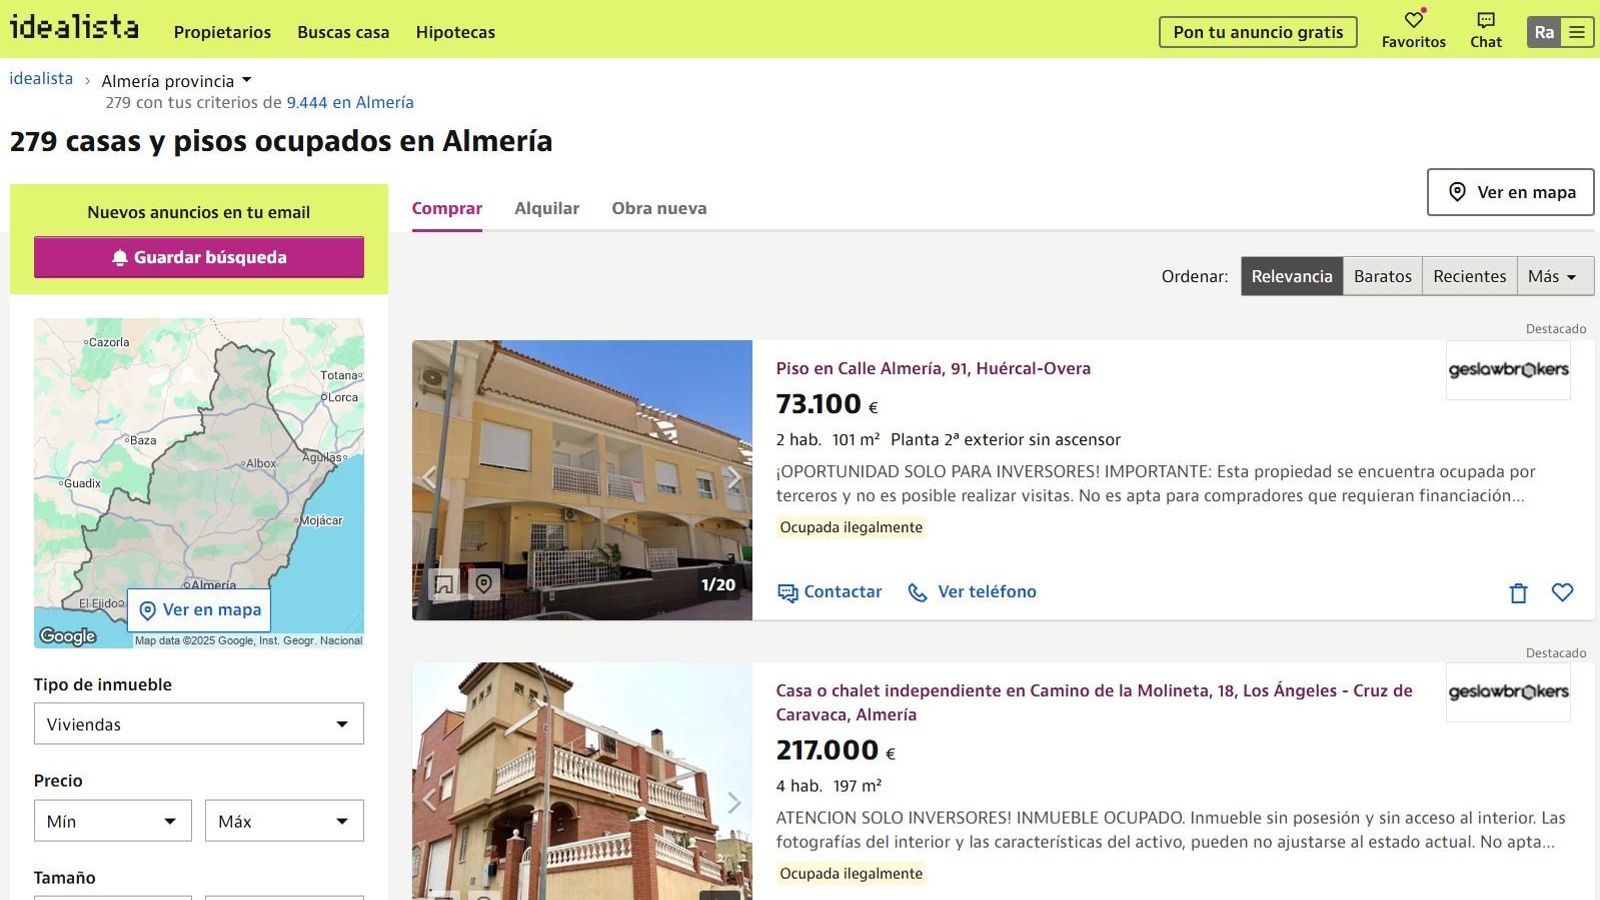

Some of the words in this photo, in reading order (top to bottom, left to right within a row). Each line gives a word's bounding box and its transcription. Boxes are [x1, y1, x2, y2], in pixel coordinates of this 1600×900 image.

[9, 13, 139, 41] idealista
[174, 24, 272, 42] Propietarios
[297, 24, 351, 39] Buscas
[355, 28, 390, 39] casa
[416, 25, 496, 42] Hipotecas
[1173, 25, 1205, 39] Pon
[1207, 26, 1226, 39] tu
[1230, 25, 1294, 39] anuncio
[1297, 25, 1344, 42] gratis
[1535, 25, 1555, 39] Ra
[1382, 35, 1447, 48] Favoritos
[1470, 35, 1503, 49] Chat
[9, 71, 73, 85] idealista
[101, 74, 160, 88] Almería
[165, 74, 235, 91] provincia
[196, 95, 258, 109] criterios
[286, 96, 328, 109] 9.444
[355, 95, 414, 109] Almería
[66, 134, 141, 153] casas
[174, 128, 247, 158] pisos
[255, 128, 392, 158] ocupados
[441, 128, 553, 153] Almería
[1477, 185, 1504, 199] Ver
[1508, 188, 1528, 199] en
[1532, 188, 1577, 202] mapa
[87, 205, 146, 219] Nuevos
[149, 205, 219, 219] anuncios
[246, 206, 264, 219] tu
[267, 205, 310, 219] email
[411, 201, 484, 218] Comprar
[514, 201, 581, 218] Alquilar
[611, 201, 653, 215] Obra
[657, 204, 707, 215] nueva
[133, 249, 202, 265] Guardar
[205, 249, 288, 267] búsqueda
[1161, 269, 1229, 283] Ordenar:
[1252, 268, 1333, 284] Relevancia
[1354, 269, 1413, 283] Baratos
[1434, 269, 1507, 283] Recientes
[1528, 269, 1560, 283] Más
[1526, 323, 1587, 334] Destacado
[89, 336, 130, 348] Cazorla
[320, 370, 356, 381] Totana
[776, 361, 810, 376] Piso
[837, 361, 877, 375] Calle
[879, 361, 946, 378] Almería,
[976, 361, 1092, 376] Huércal-Overa
[328, 391, 358, 402] Lorca
[775, 392, 862, 415] 73.100
[130, 435, 156, 446] Baza
[789, 432, 822, 447] hab.
[890, 432, 940, 447] Planta
[963, 432, 1025, 447] exterior
[1055, 435, 1122, 447] ascensor
[246, 458, 276, 468] Albox
[776, 464, 900, 481] ¡OPORTUNIDAD
[904, 464, 947, 479] SOLO
[951, 464, 993, 478] PARA
[996, 464, 1100, 479] INVERSORES!
[1105, 464, 1212, 479] IMPORTANTE:
[1217, 464, 1249, 479] Esta
[1254, 464, 1332, 481] propiedad
[1358, 465, 1435, 479] encuentra
[1439, 464, 1505, 481] ocupada
[64, 478, 101, 489] Guadix
[776, 489, 838, 503] terceros
[901, 488, 957, 505] posible
[961, 488, 1017, 503] realizar
[1021, 488, 1074, 503] visitas.
[1126, 489, 1161, 505] apta
[1166, 491, 1199, 505] para
[1204, 488, 1304, 505] compradores
[1308, 491, 1337, 505] que
[1342, 488, 1415, 506] requieran
[1418, 488, 1525, 503] financiación...
[300, 514, 342, 526] Mojácar
[779, 520, 840, 536] Ocupada
[843, 520, 923, 537] ilegalmente
[192, 580, 236, 589] Almería
[701, 576, 736, 592] 1/20
[804, 584, 883, 599] Contactar
[937, 584, 965, 599] Ver
[968, 584, 1037, 599] teléfono
[79, 598, 89, 608] El
[92, 598, 117, 609] Ejido
[162, 602, 190, 617] Ver
[193, 605, 214, 617] en
[218, 605, 262, 620] mapa
[39, 626, 97, 648] Google
[135, 635, 157, 647] Map
[158, 635, 181, 646] data
[182, 635, 216, 646] ©2025
[218, 635, 256, 648] Google,
[259, 635, 280, 646] Inst.
[283, 635, 317, 648] Geogr.
[320, 635, 363, 646] Nacional
[1526, 647, 1587, 659] Destacado
[33, 677, 69, 695] Tipo
[73, 677, 94, 692] de
[97, 677, 173, 692] inmueble
[775, 683, 812, 698] Casa
[831, 683, 881, 698] chalet
[885, 683, 1002, 701] independiente
[1029, 683, 1090, 698] Camino
[1137, 683, 1213, 700] Molineta,
[1217, 684, 1239, 700] 18,
[1243, 683, 1270, 698] Los
[1273, 680, 1338, 701] Ángeles
[1353, 683, 1389, 698] Cruz
[775, 707, 851, 724] Caravaca,
[855, 707, 917, 722] Almería
[46, 717, 121, 732] Viviendas
[776, 738, 879, 761] 217.000
[34, 773, 83, 788] Precio
[775, 779, 786, 793] 4
[790, 778, 823, 793] hab.
[833, 779, 858, 793] 197
[47, 814, 76, 829] Mín
[218, 814, 252, 829] Máx
[775, 810, 857, 825] ATENCION
[861, 810, 904, 825] SOLO
[908, 810, 1012, 825] INVERSORES!
[1017, 810, 1099, 825] INMUEBLE
[1103, 810, 1186, 825] OCUPADO.
[1190, 810, 1262, 825] Inmueble
[1266, 810, 1288, 825] sin
[1293, 810, 1360, 828] posesión
[1379, 810, 1401, 825] sin
[1405, 813, 1456, 825] acceso
[1478, 810, 1537, 825] interior.
[1542, 810, 1566, 825] Las
[776, 834, 861, 852] fotografías
[865, 834, 889, 849] del
[894, 834, 951, 849] interior
[969, 834, 990, 849] las
[994, 834, 1103, 849] características
[1107, 834, 1131, 849] del
[1135, 834, 1186, 851] activo,
[1191, 834, 1248, 852] pueden
[1277, 834, 1346, 852] ajustarse
[1368, 834, 1421, 849] estado
[1425, 834, 1476, 849] actual.
[1507, 835, 1555, 852] apta...
[33, 870, 96, 885] Tamaño
[779, 866, 840, 883] Ocupada
[843, 866, 924, 883] ilegalmente
